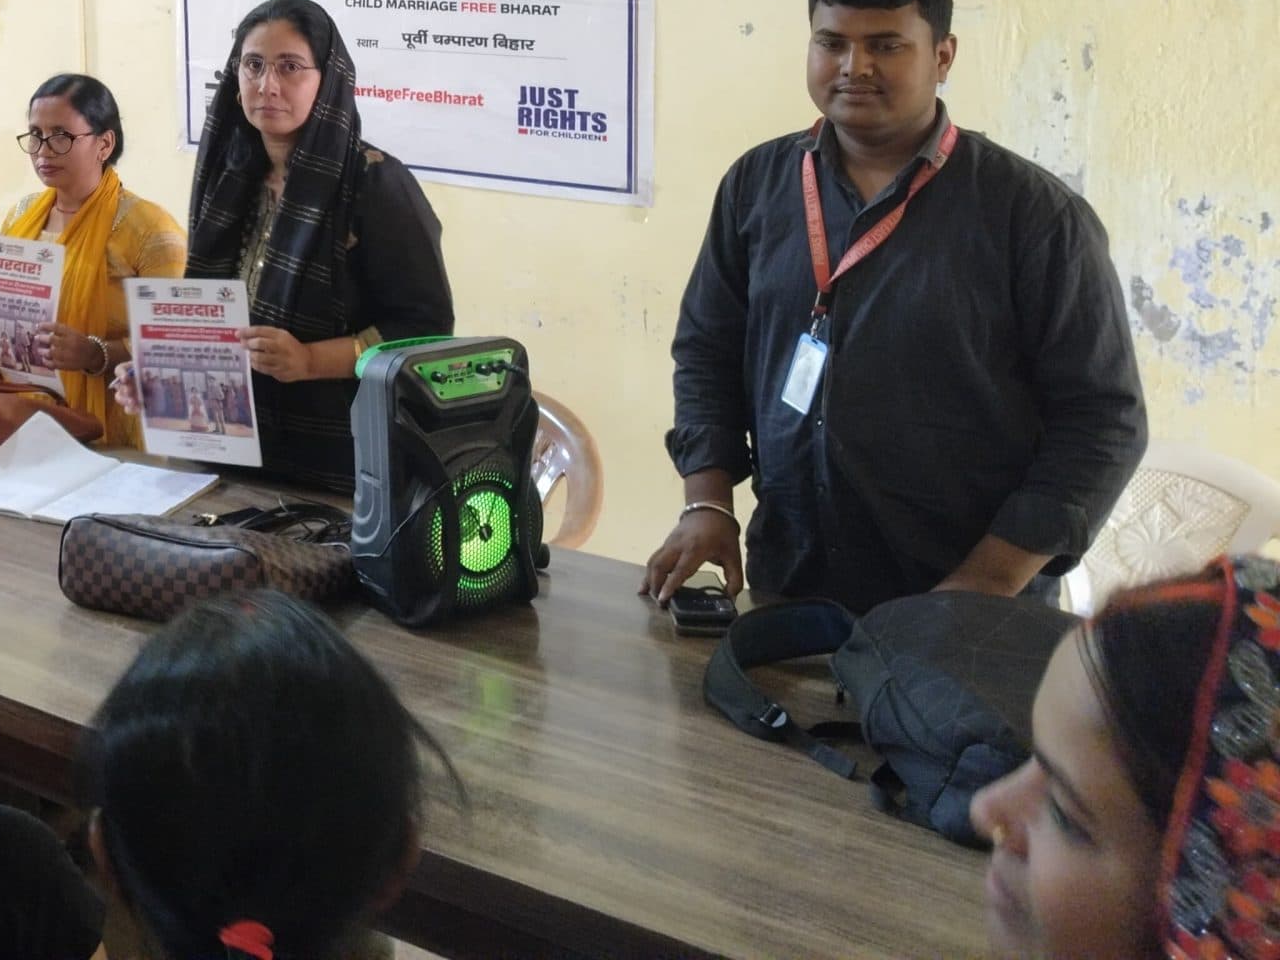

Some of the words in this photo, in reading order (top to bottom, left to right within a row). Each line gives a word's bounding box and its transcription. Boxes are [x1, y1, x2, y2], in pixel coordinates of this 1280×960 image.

[386, 0, 457, 12] MARRIAGE
[461, 2, 496, 13] FREE
[500, 4, 560, 16] BHARAT
[356, 38, 378, 49] स्थान
[402, 30, 428, 49] पूर्वी
[432, 34, 488, 48] चम्पारण
[493, 33, 535, 51] बिहार
[353, 84, 484, 107] arriageFreeBharat
[519, 85, 579, 109] JUST
[518, 106, 608, 133] RIGHTS
[530, 129, 549, 137] FOR
[552, 130, 601, 141] CHILDREN
